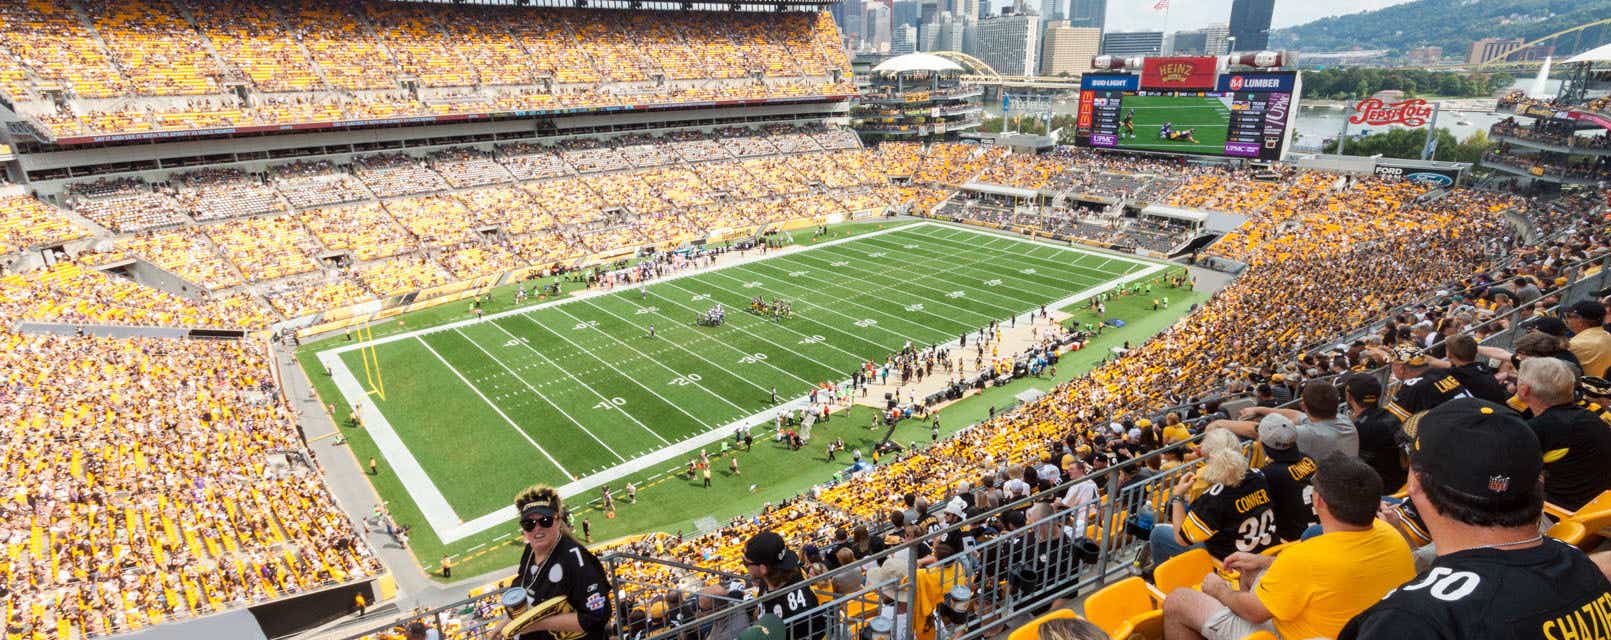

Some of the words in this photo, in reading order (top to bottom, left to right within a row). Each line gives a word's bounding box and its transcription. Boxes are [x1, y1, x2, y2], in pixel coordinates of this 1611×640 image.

[1159, 64, 1193, 76] HEINZ
[1091, 79, 1106, 87] BUD
[1106, 79, 1127, 87] LIGHT
[1244, 78, 1280, 88] LUMBER
[1375, 167, 1403, 175] FORD
[741, 352, 767, 364] 30
[672, 373, 702, 386] 20
[600, 397, 626, 410] 10
[1234, 489, 1270, 513] CONNER
[1234, 508, 1276, 552] 30
[567, 546, 584, 568] 7
[787, 588, 807, 612] 84
[1542, 592, 1611, 640] SHAZIE
